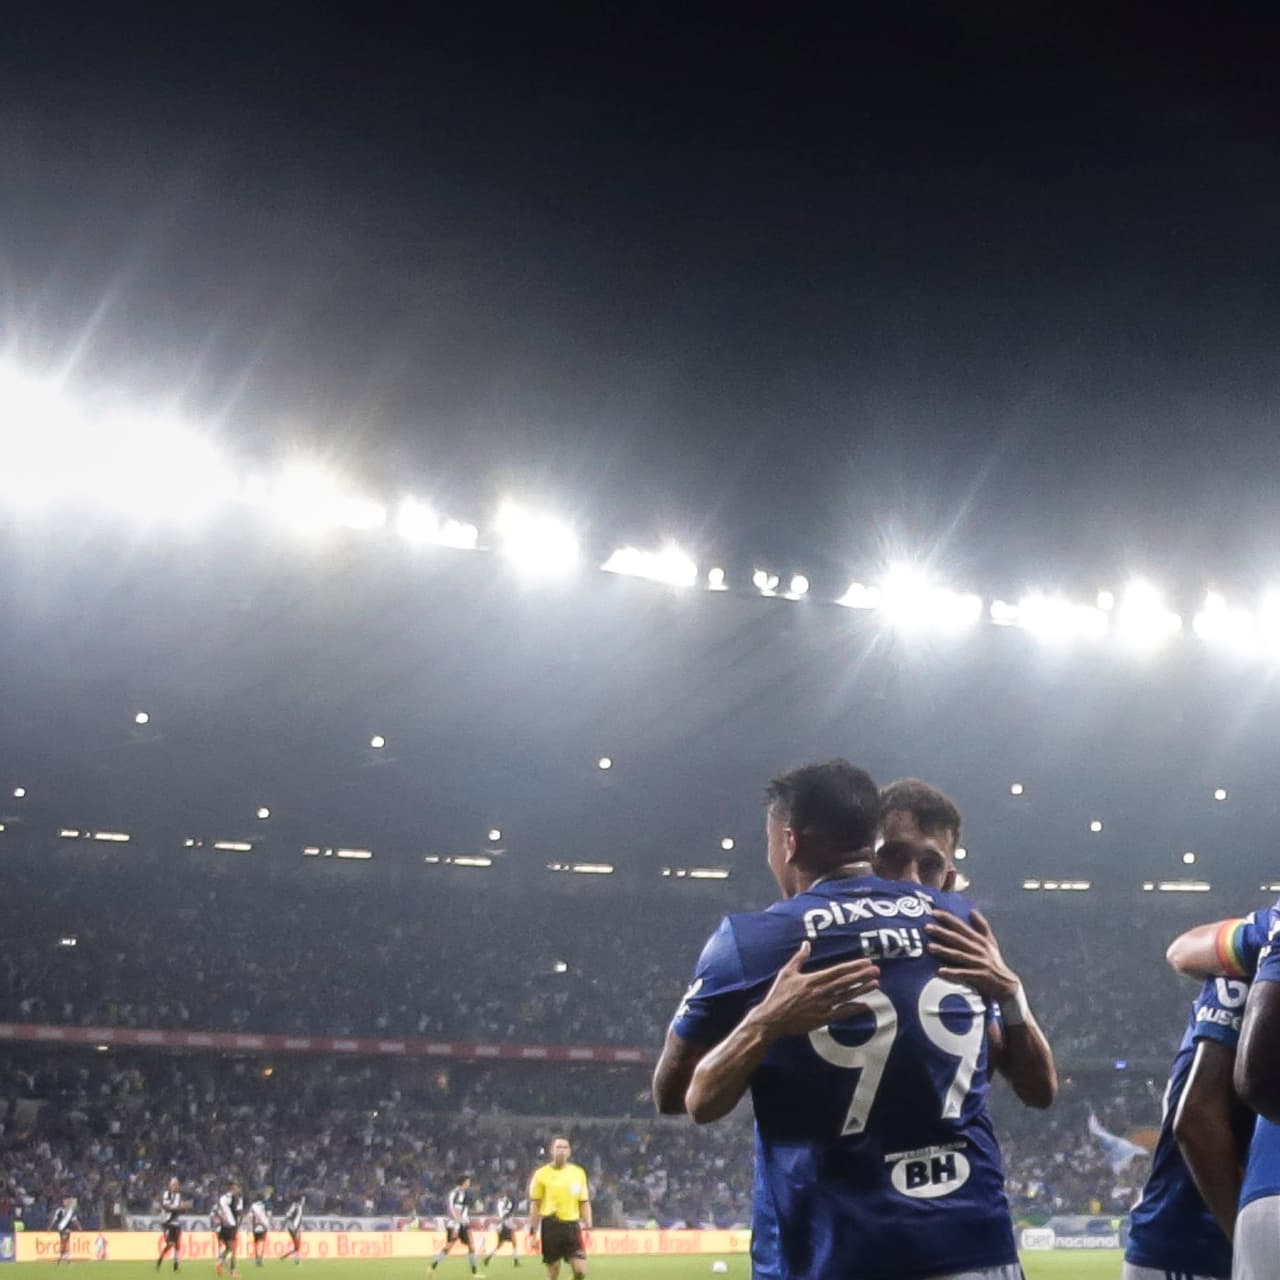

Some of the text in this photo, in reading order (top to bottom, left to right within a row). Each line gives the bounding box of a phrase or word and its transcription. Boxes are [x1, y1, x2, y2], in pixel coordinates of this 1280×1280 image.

[803, 891, 935, 938] pixbet
[860, 928, 923, 960] EDU
[808, 977, 987, 1136] 99
[906, 1154, 956, 1190] BH
[337, 1233, 393, 1258] Brasil
